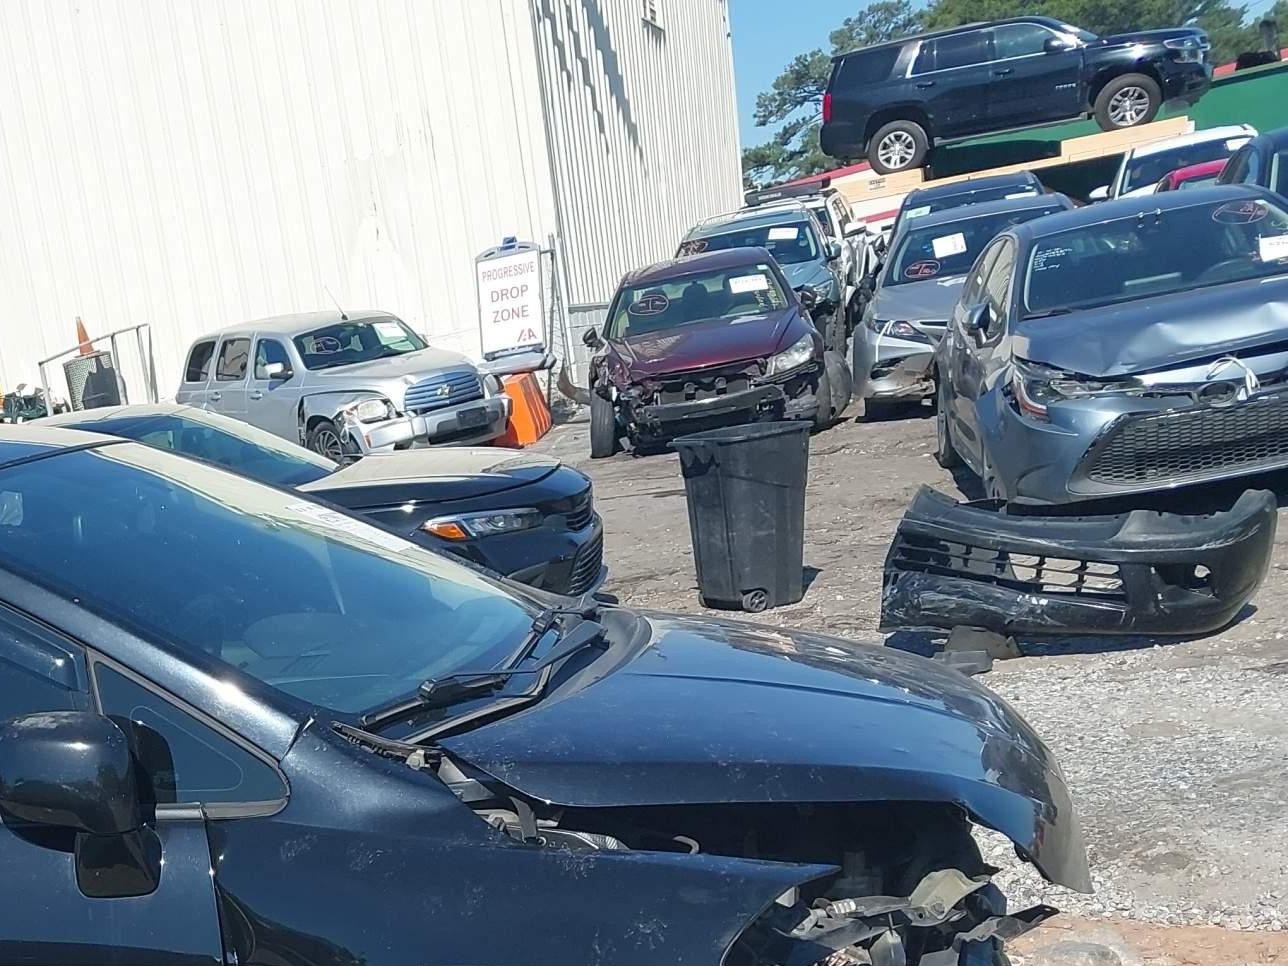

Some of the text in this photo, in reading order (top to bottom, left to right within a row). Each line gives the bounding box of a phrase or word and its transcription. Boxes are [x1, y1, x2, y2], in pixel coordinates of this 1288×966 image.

[481, 261, 535, 282] PROGRESSIVE
[491, 284, 529, 303] DROP
[492, 304, 530, 323] ZONE
